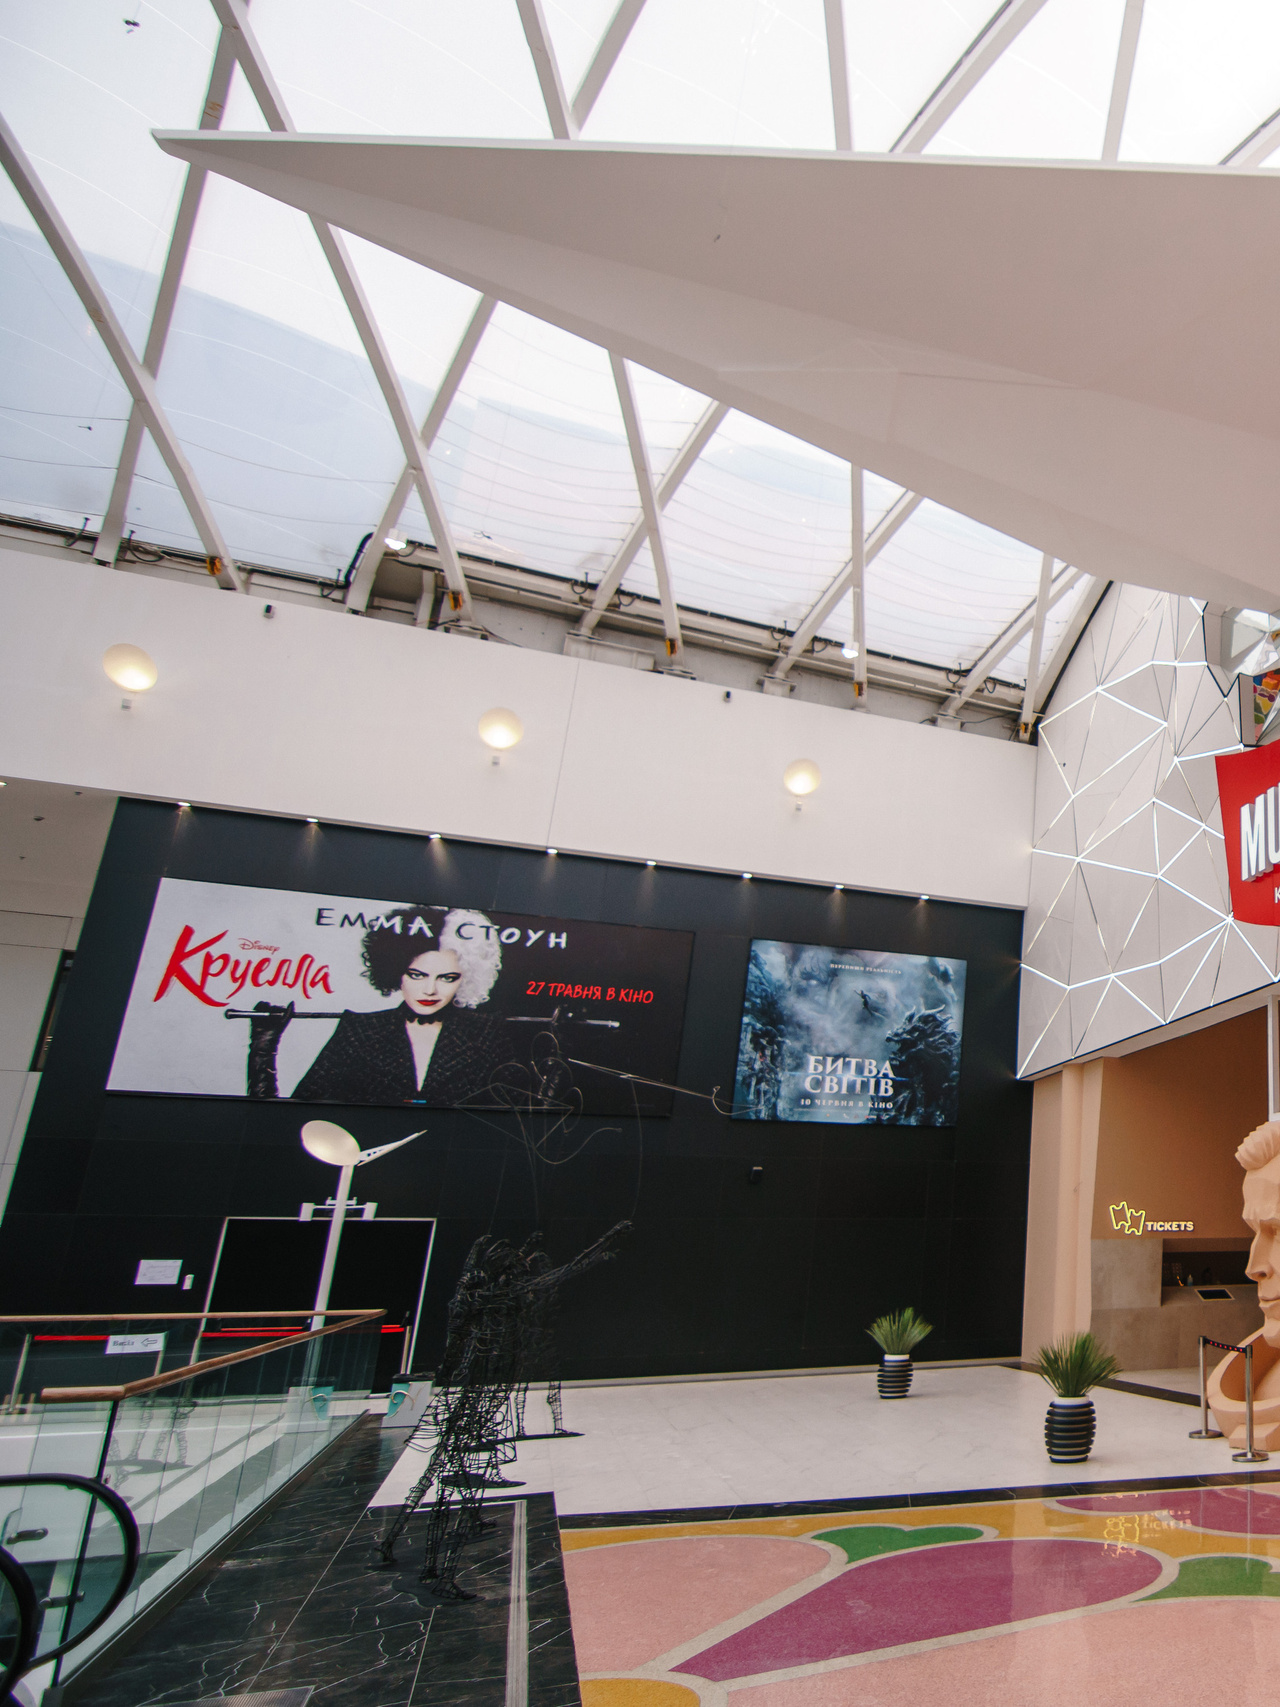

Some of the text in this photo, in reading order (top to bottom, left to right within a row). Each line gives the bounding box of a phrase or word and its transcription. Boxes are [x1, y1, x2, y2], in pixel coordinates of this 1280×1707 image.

[315, 907, 568, 950] ЕММА СТОУН
[153, 924, 335, 1008] Круелла
[526, 981, 654, 1004] 27 ТРАВНЯ В КІНО
[808, 1055, 897, 1078] БИТВА
[804, 1074, 895, 1097] СВІТІВ
[815, 1098, 855, 1108] ЧЕРВНЯ
[867, 1101, 895, 1110] КІНО
[1145, 1222, 1194, 1231] TICKETS
